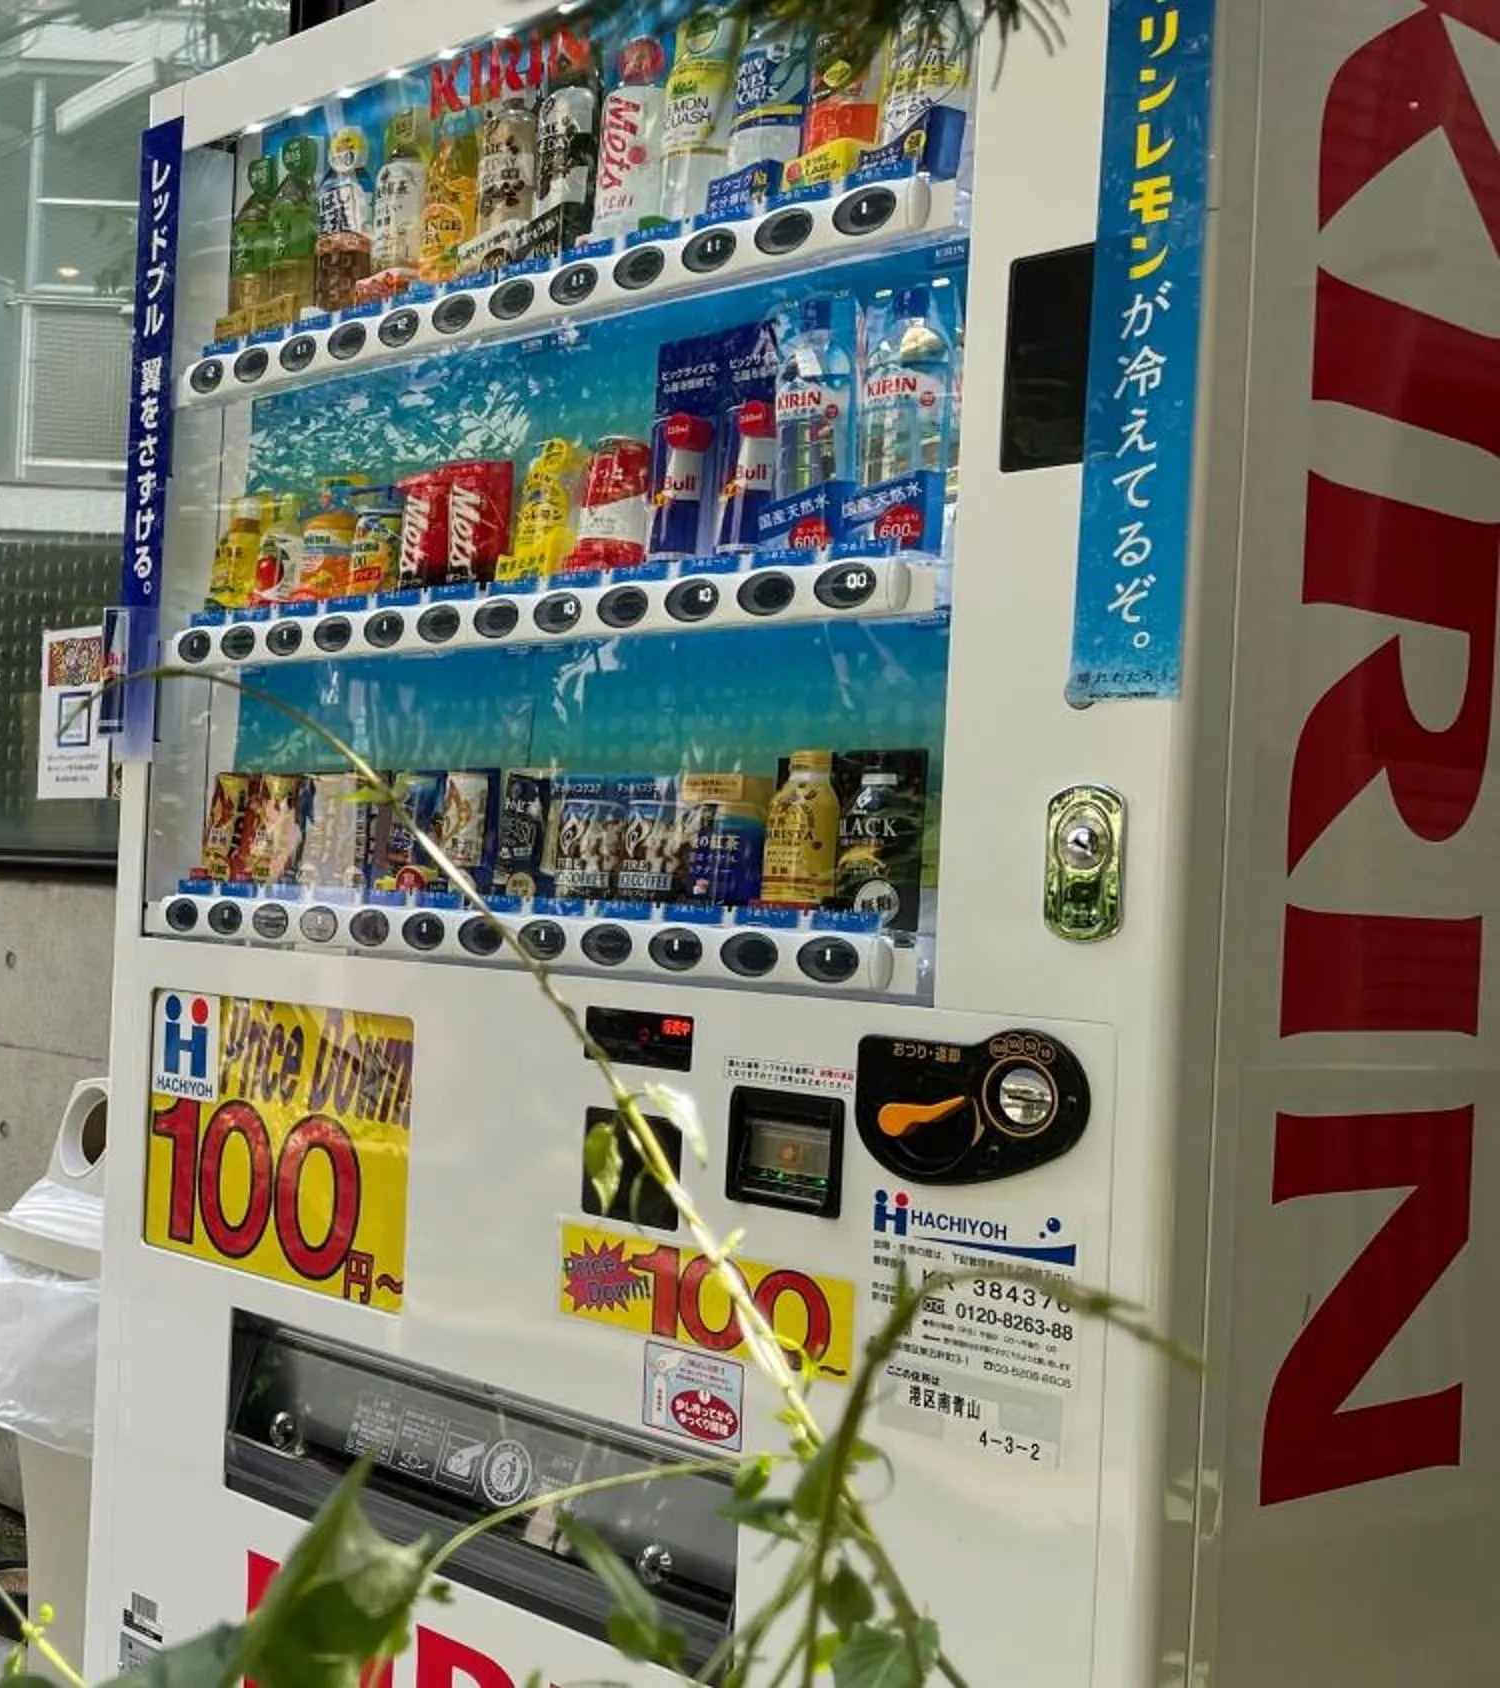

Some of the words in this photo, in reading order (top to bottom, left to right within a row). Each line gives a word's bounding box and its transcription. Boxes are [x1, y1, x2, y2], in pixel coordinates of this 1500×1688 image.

[430, 22, 591, 121] KIRIN
[667, 96, 710, 116] EMON
[142, 158, 171, 339] レッドブル
[1107, 0, 1179, 650] リンレモンが冷えてるぞ。
[777, 390, 822, 411] KIRIN
[867, 376, 919, 399] KIRIN
[133, 356, 164, 597] 翼をさずける。
[758, 493, 831, 531] 国産天然水
[842, 480, 923, 518] 国産天然水
[691, 834, 741, 852] の紅茶
[220, 999, 304, 1105] Price
[892, 1042, 962, 1064] おつり・返却
[156, 1075, 214, 1099] HACHIYOH
[910, 1208, 1008, 1242] HACHIYOH
[563, 1255, 617, 1279] Price
[586, 1276, 650, 1302] Down!
[954, 1302, 1074, 1342] 0120-8263-88
[908, 1383, 981, 1421] 港区南青山
